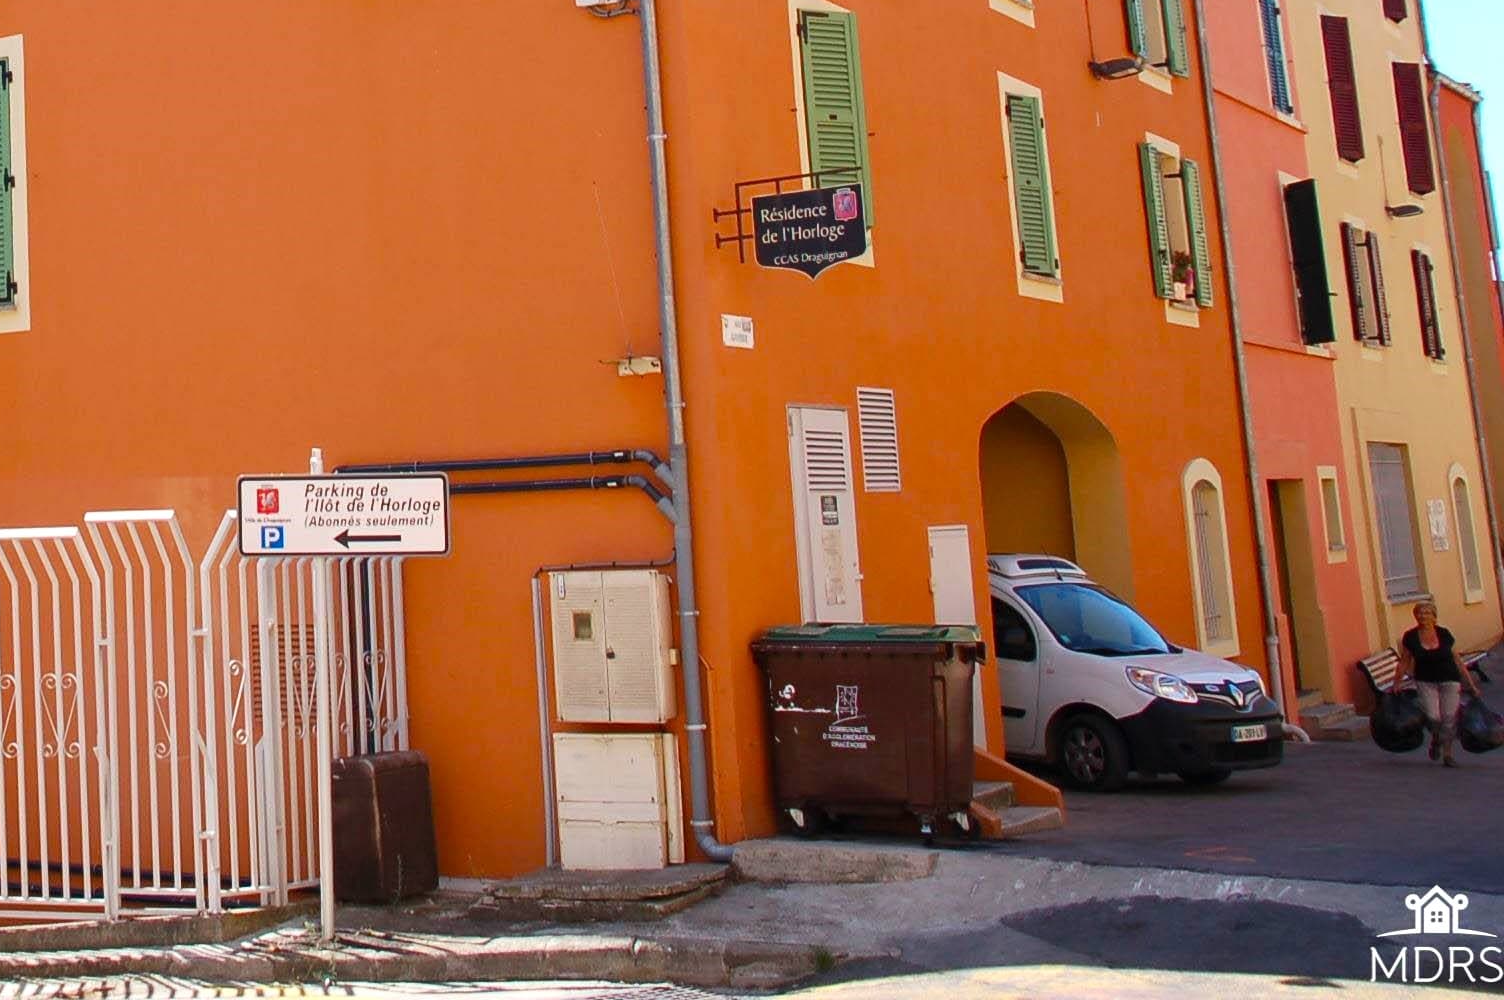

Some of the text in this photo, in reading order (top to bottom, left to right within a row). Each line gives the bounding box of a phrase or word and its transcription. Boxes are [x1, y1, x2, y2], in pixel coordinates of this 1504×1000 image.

[760, 204, 827, 223] Résidence
[761, 223, 845, 244] de l'Horloge
[773, 251, 848, 266] CCAS Draguignan
[304, 482, 388, 500] Parking de
[346, 498, 364, 512] de
[370, 497, 441, 514] l'Horloge
[304, 514, 434, 528] (Abonnés seulement)
[264, 527, 280, 548] P
